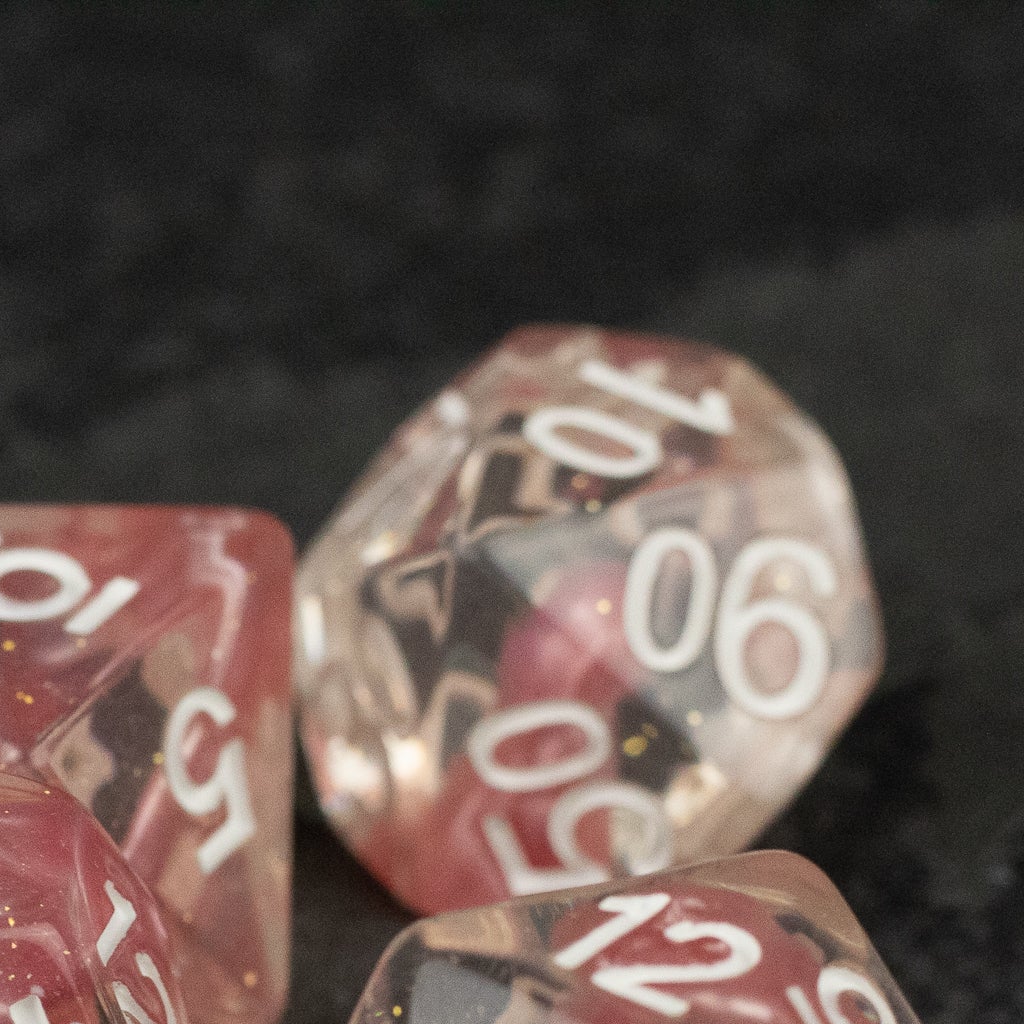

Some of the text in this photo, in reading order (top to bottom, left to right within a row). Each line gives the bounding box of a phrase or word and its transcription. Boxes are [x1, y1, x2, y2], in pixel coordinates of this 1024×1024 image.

[524, 360, 734, 478] 10
[164, 688, 256, 874] 5
[556, 893, 762, 1017] 12
